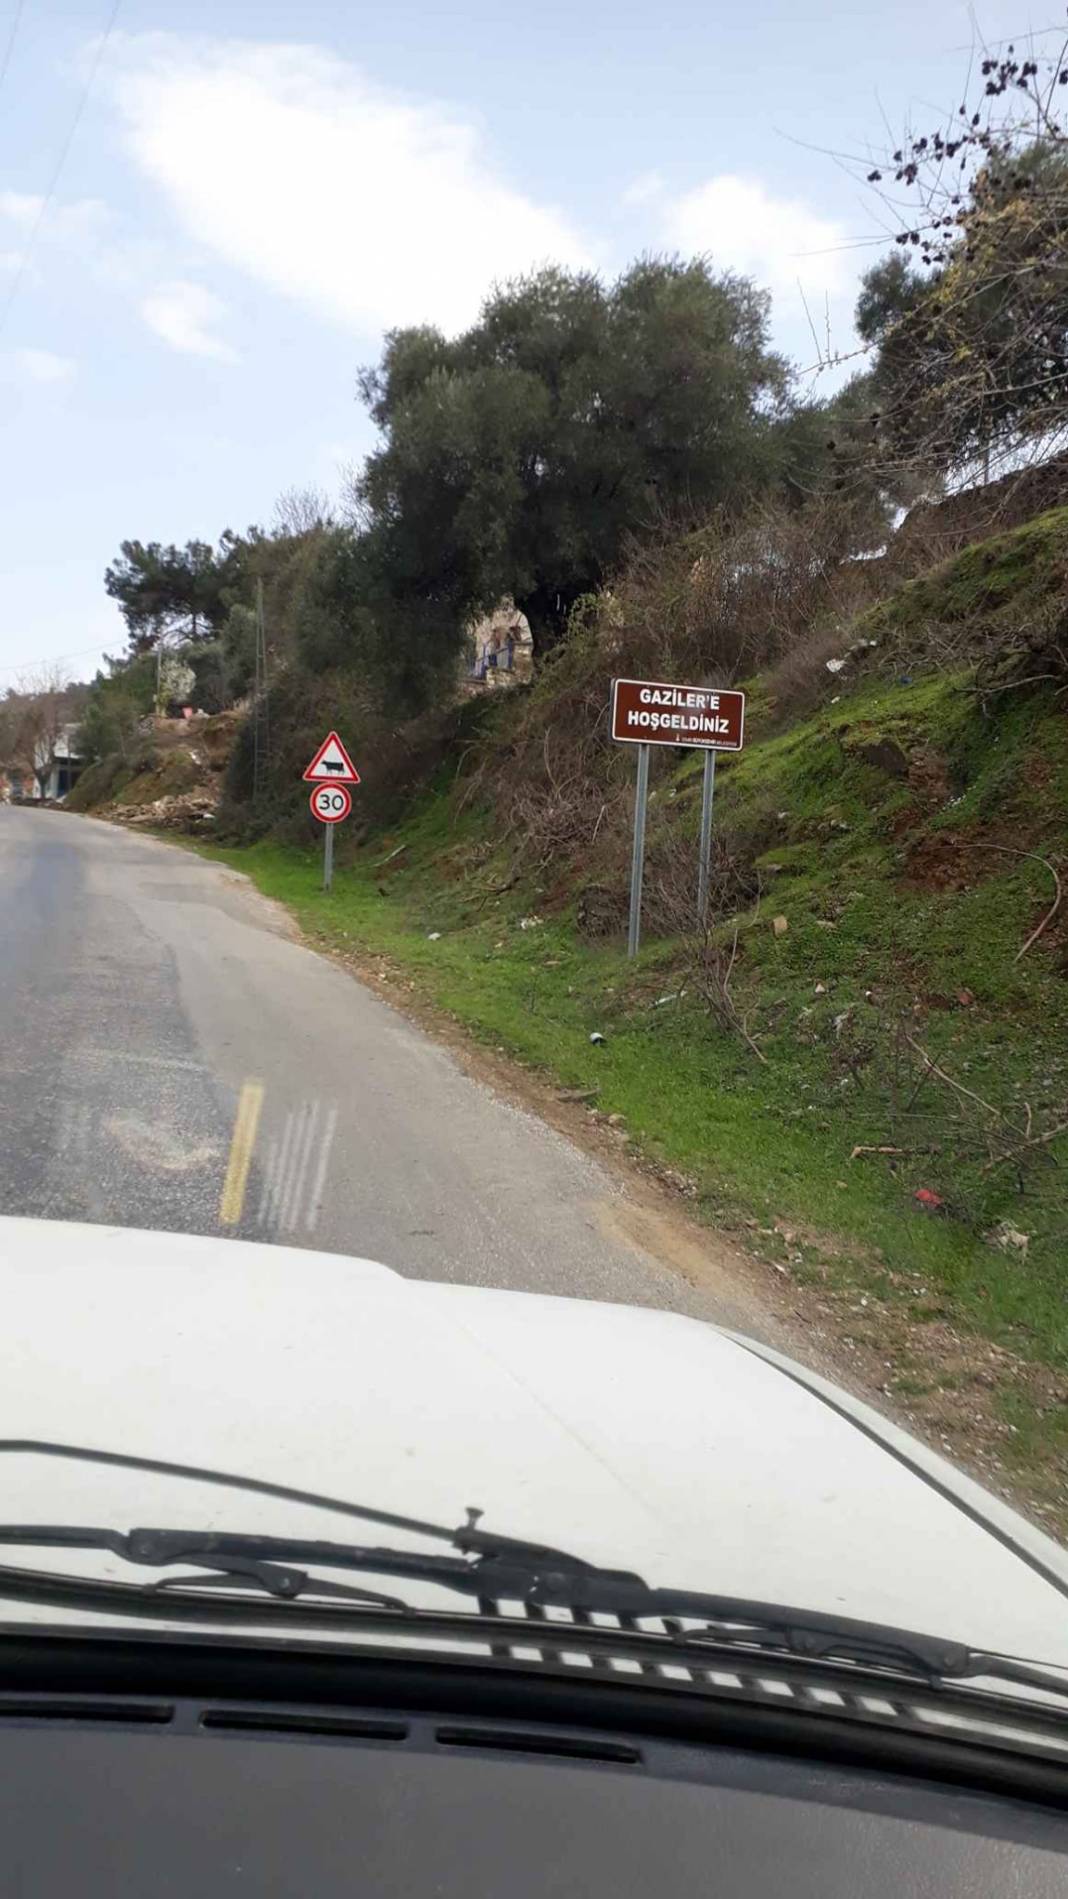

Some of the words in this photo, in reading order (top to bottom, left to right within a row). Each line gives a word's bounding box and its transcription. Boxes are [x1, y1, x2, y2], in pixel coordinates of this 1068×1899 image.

[640, 688, 720, 710] GAZİLER'E
[627, 710, 729, 733] HOŞGELDİNİZ
[319, 794, 344, 811] 30
